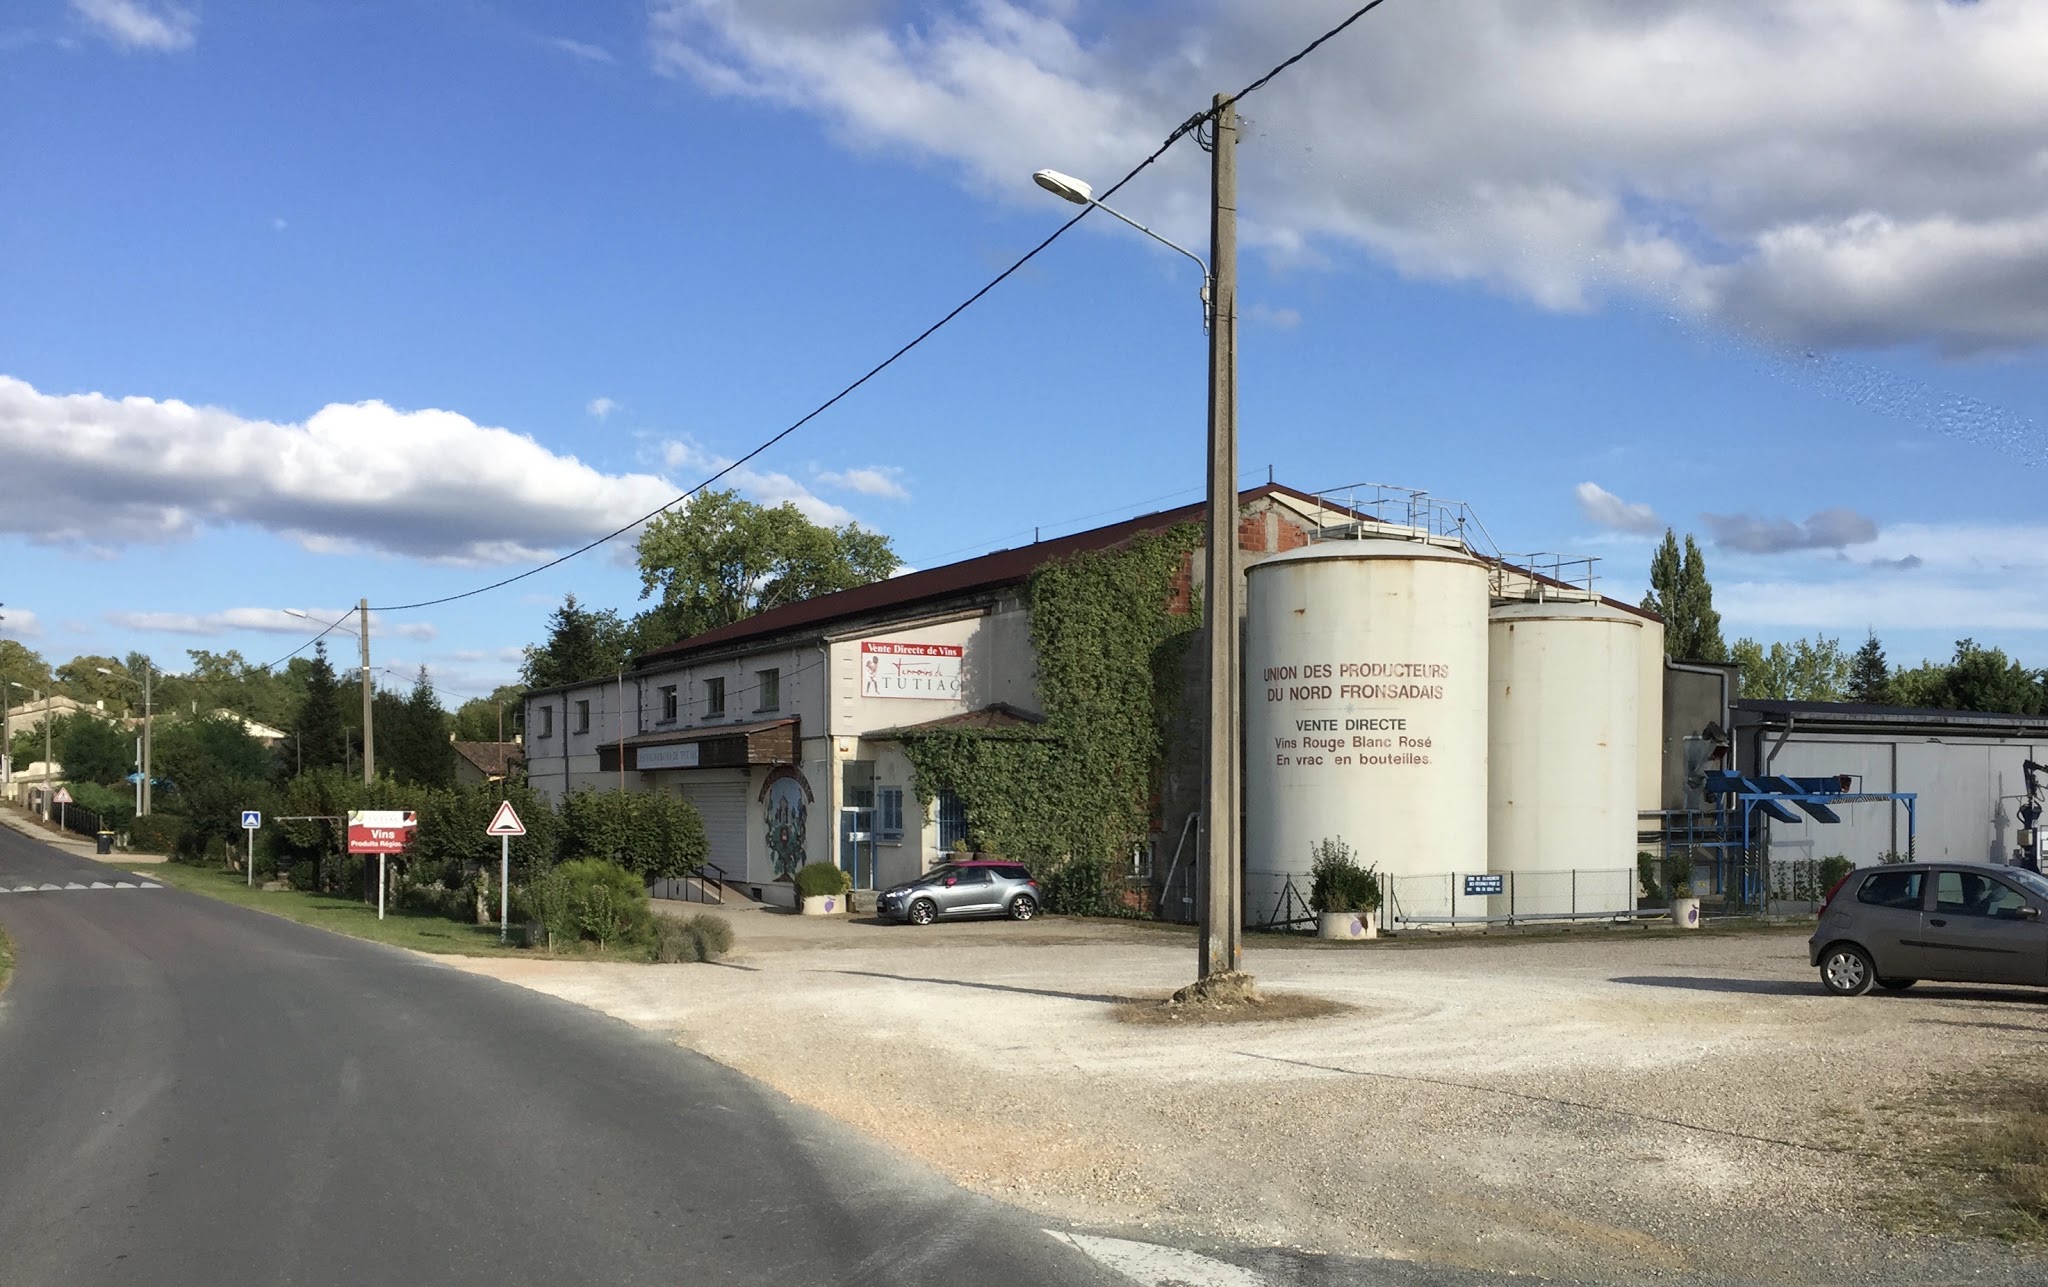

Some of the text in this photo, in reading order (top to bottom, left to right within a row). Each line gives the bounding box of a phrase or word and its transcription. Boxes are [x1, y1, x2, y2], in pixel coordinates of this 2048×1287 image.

[868, 643, 957, 655] Vente Directe de Vins
[1263, 663, 1449, 682] UNION DES PRODUCTEURS
[882, 676, 961, 691] TUTIAC
[1267, 684, 1443, 702] DU NORD FRONSADAIS
[1296, 718, 1406, 731] VENTE DIRECTE
[1275, 736, 1432, 752] Vins Rouge Blanc Rosé
[1276, 754, 1290, 766] En
[1296, 754, 1323, 766] vrac
[1334, 755, 1352, 765] en
[371, 829, 395, 839] Vins
[380, 840, 403, 848] Région
